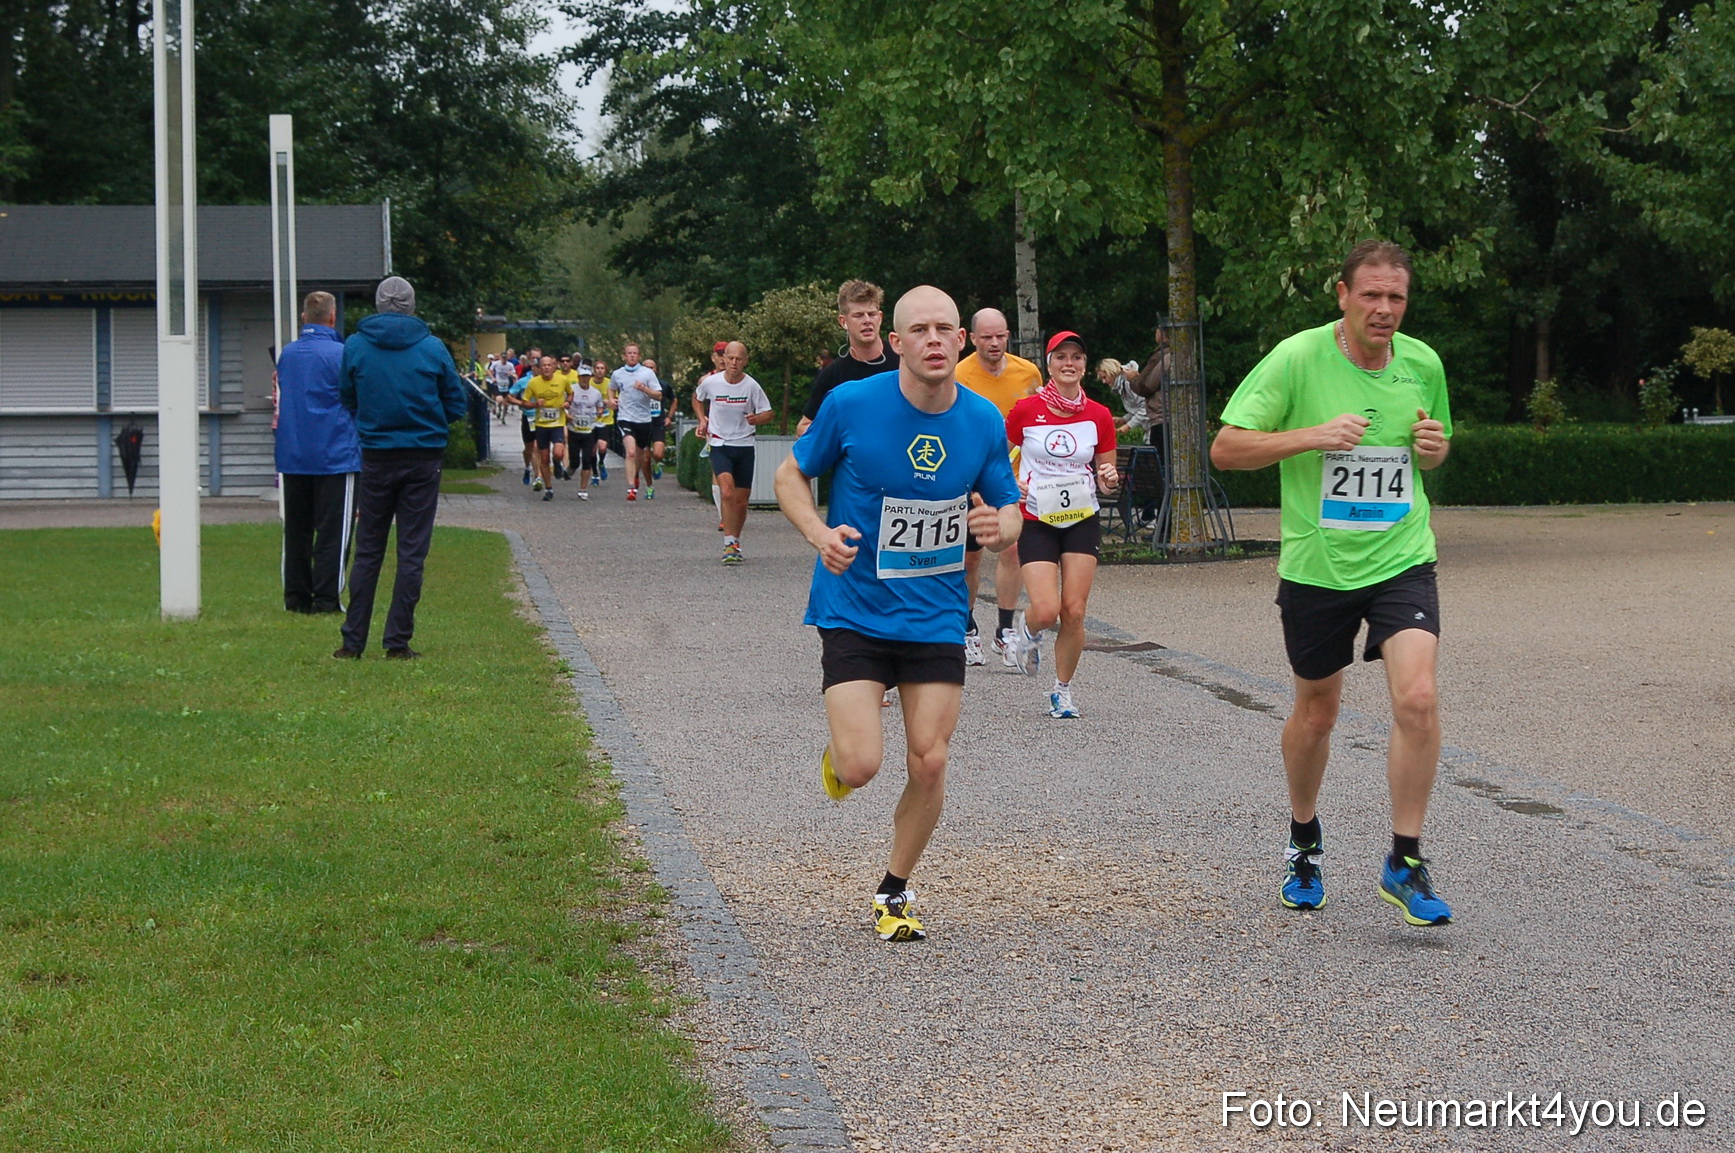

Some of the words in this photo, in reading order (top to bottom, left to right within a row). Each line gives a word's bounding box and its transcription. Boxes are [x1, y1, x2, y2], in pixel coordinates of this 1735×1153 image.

[1325, 453, 1356, 462] PARTL
[1358, 454, 1399, 463] Neumarkt
[1331, 466, 1404, 498] 2114
[1060, 489, 1071, 508] 3
[884, 505, 916, 515] PARTL
[917, 504, 957, 516] Neumarkt
[1349, 506, 1384, 518] Armin
[1049, 511, 1085, 524] Stephanie
[889, 514, 960, 548] 2115
[909, 555, 937, 567] Sven
